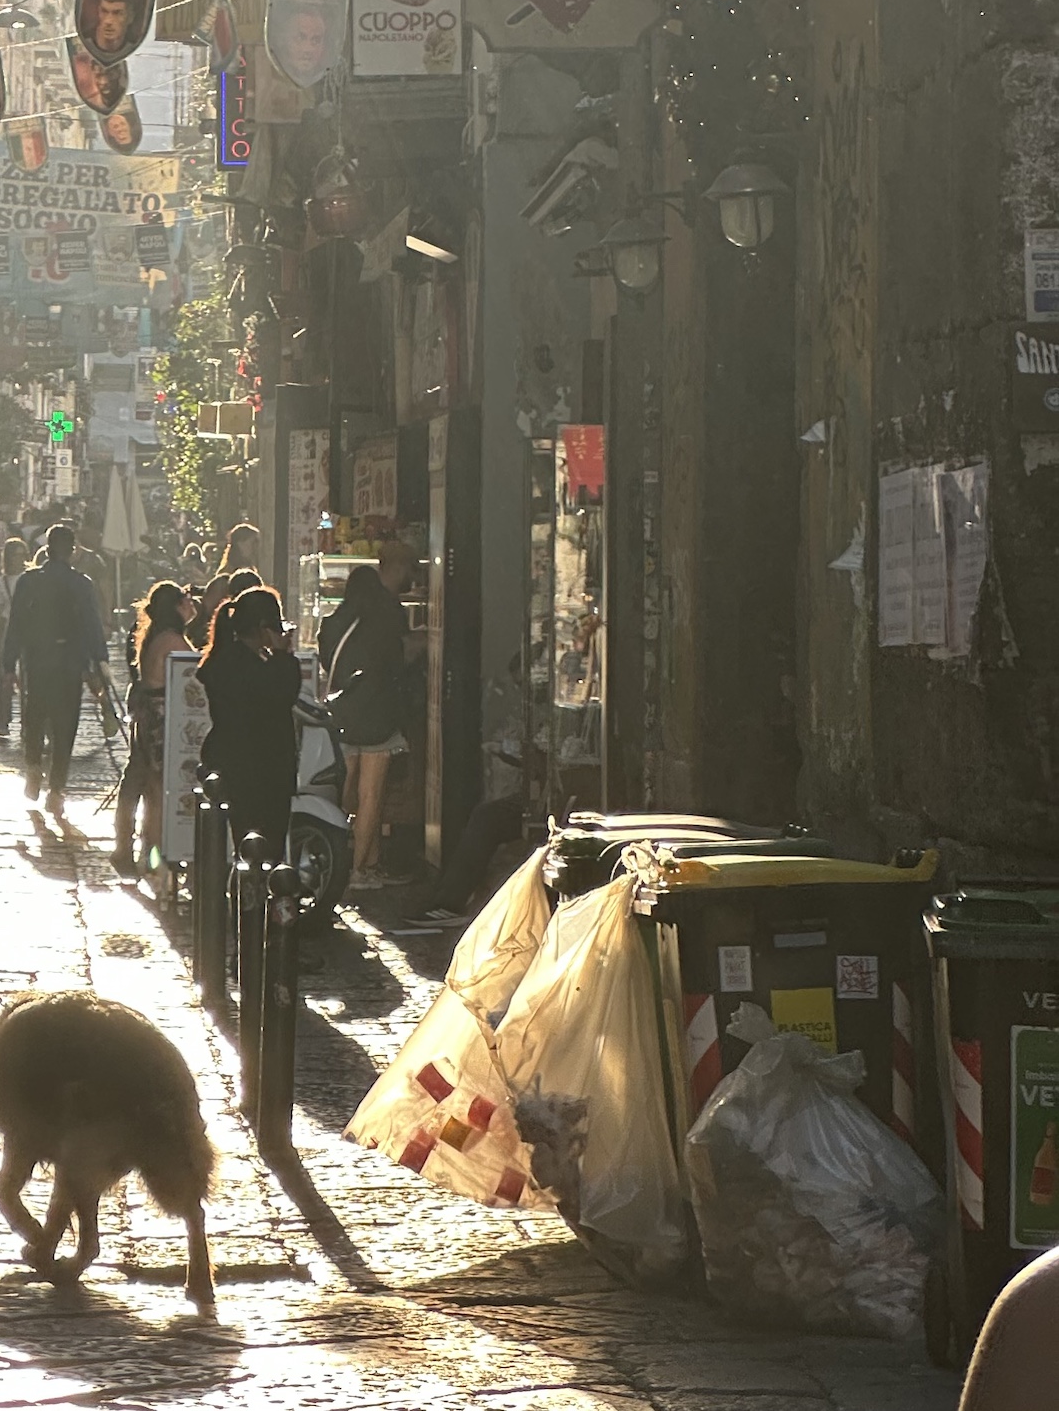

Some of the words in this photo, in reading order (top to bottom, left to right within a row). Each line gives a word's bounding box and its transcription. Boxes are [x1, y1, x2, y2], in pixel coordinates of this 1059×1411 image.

[359, 11, 456, 31] CUOPPO
[358, 33, 423, 42] NAPOLETANO
[56, 162, 112, 188] PER
[2, 182, 162, 215] REGALATO
[778, 1022, 831, 1032] PLASTICA
